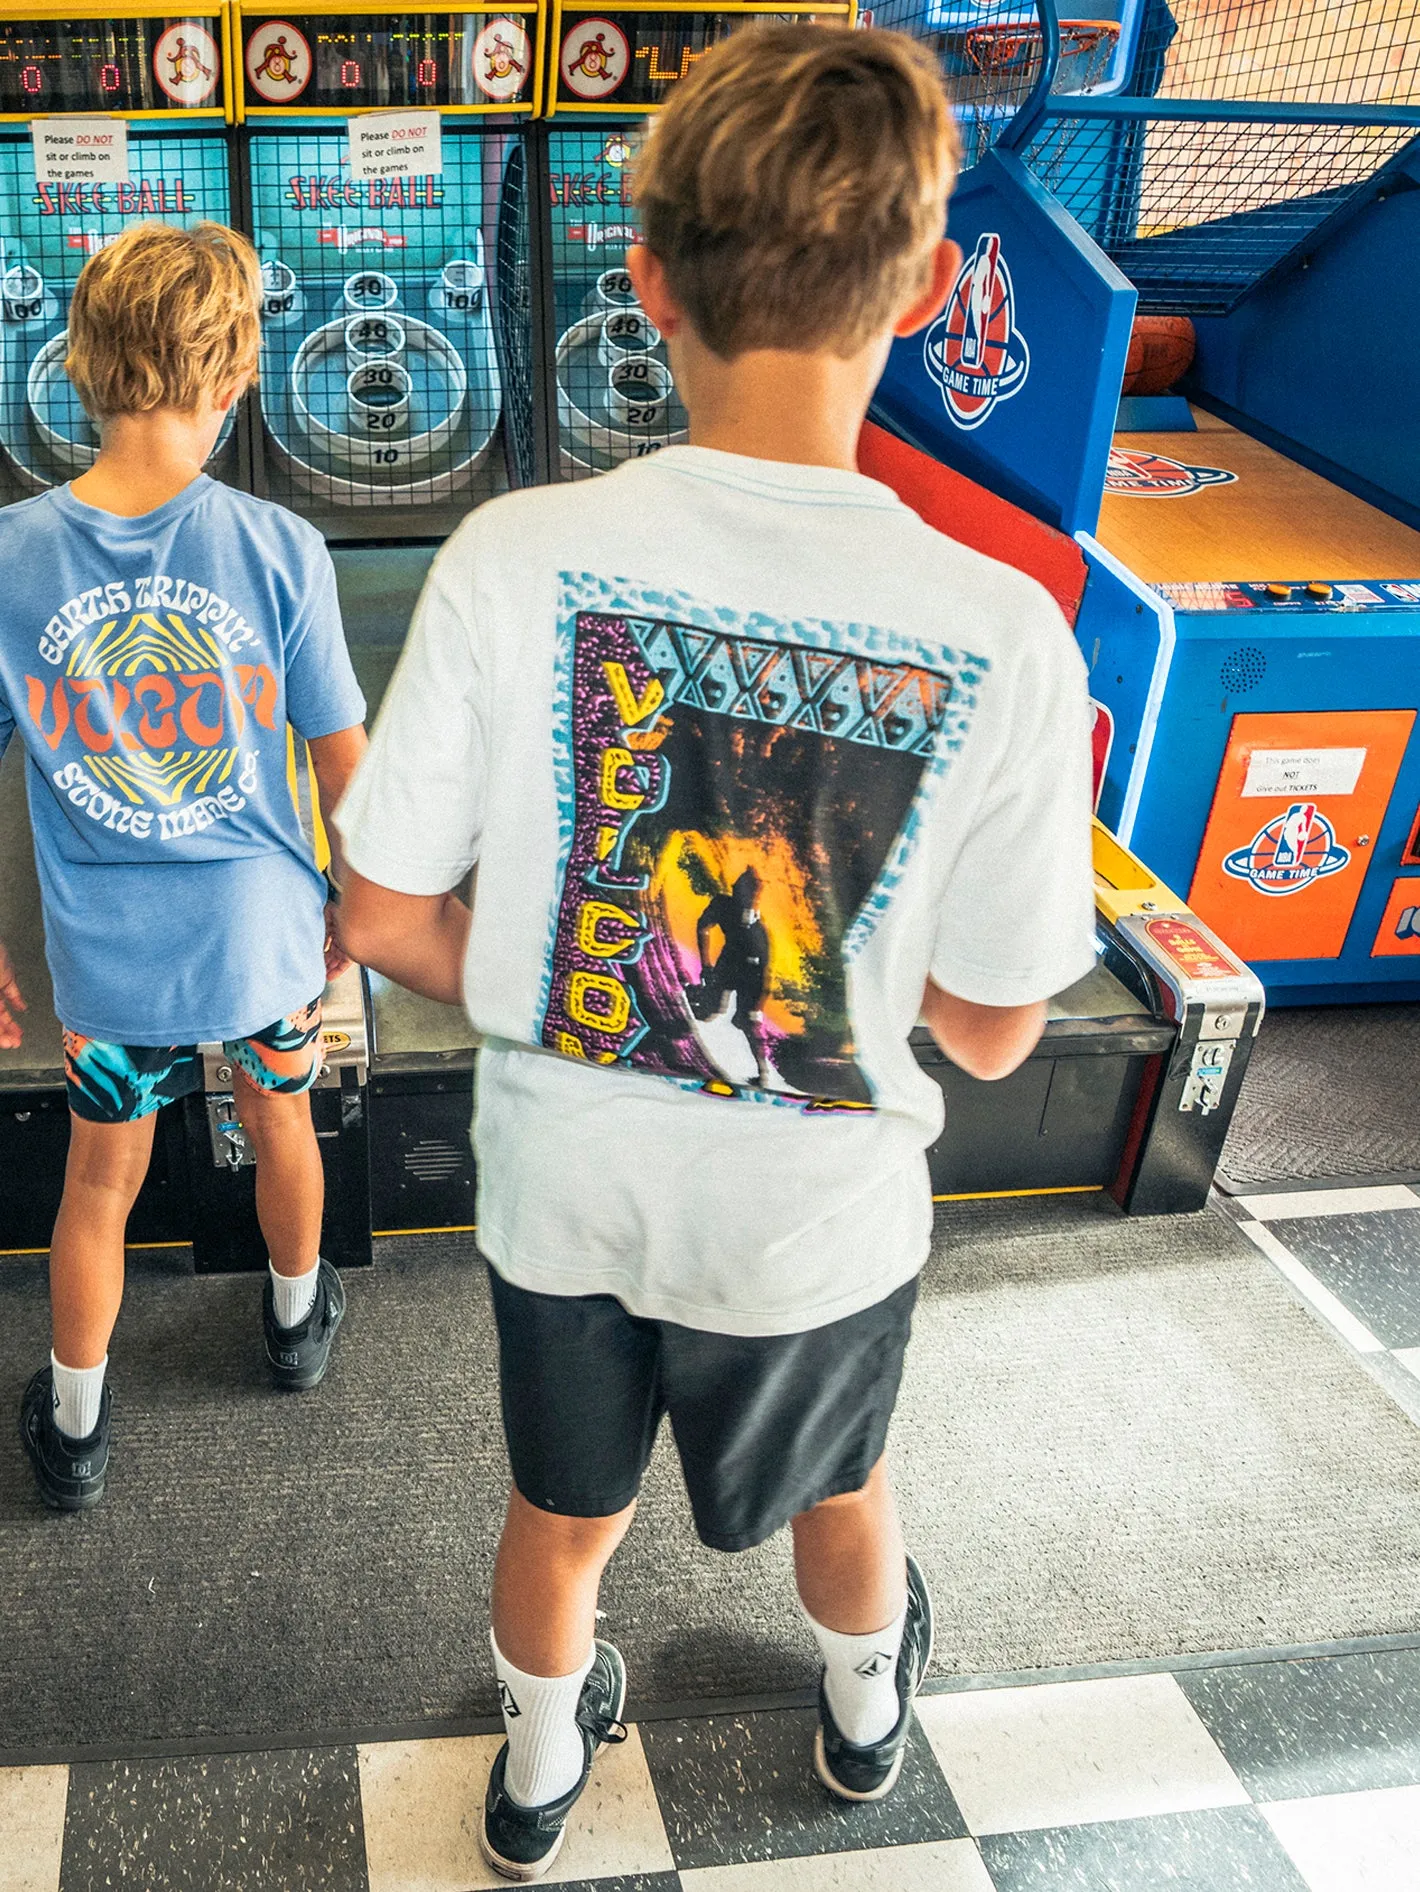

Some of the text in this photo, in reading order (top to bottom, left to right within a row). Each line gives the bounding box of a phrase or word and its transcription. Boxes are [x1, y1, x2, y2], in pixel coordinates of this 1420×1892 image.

[44, 134, 114, 146] Please DO NOT
[360, 126, 428, 142] Please DO NOT
[46, 150, 111, 162] sit or climb on
[361, 144, 425, 158] sit or climb on
[47, 168, 94, 180] the games
[362, 163, 409, 175] the games
[116, 177, 193, 214] BALL
[289, 173, 443, 210] SKEE BALL
[353, 279, 382, 298] 50
[603, 276, 632, 294] 50
[263, 293, 294, 315] 00
[358, 322, 387, 339] 40
[611, 317, 641, 334] 40
[363, 368, 393, 384] 30
[618, 363, 648, 380] 30
[942, 366, 1000, 396] GAME TIME
[367, 413, 396, 429] 20
[626, 407, 656, 424] 20
[373, 449, 398, 463] 10
[38, 575, 261, 666] EARTH TRIPPIN'
[24, 663, 278, 754] VOLCOM
[1283, 771, 1301, 780] NOT
[1289, 784, 1318, 792] TICKETS
[52, 761, 154, 839] STONE
[158, 784, 246, 841] MADE
[1276, 851, 1293, 863] NBA
[1249, 867, 1319, 880] GAME TIME
